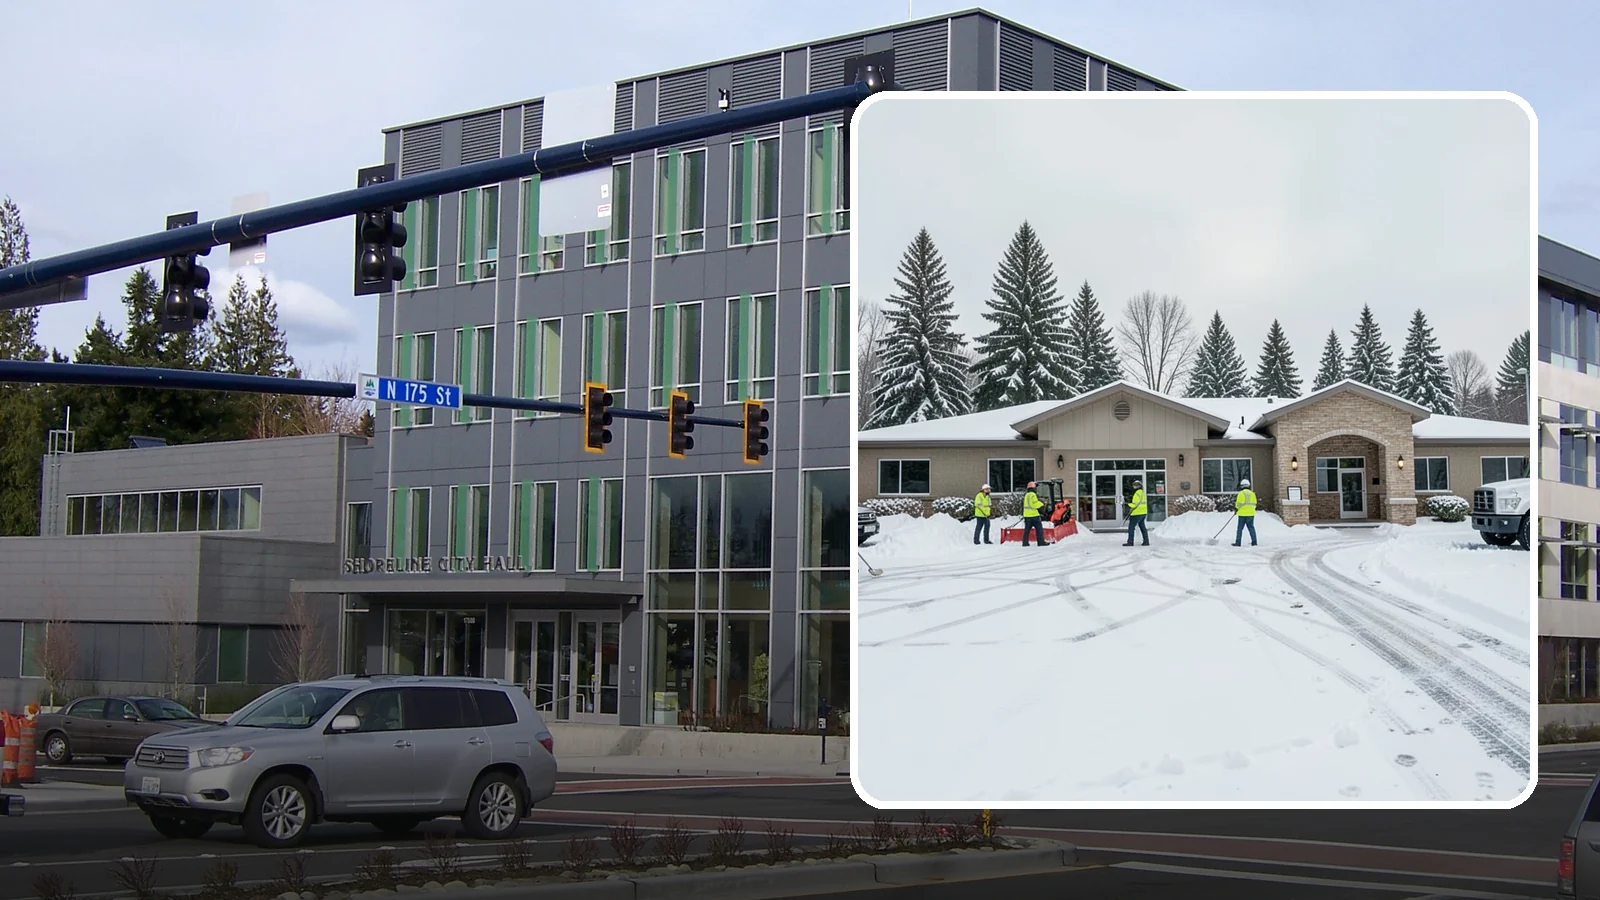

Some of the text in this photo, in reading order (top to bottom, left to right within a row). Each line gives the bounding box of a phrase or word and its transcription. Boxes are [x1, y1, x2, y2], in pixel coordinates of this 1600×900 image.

[387, 380, 451, 406] N 175 St
[343, 555, 525, 574] SHORELINE CITY HALL
